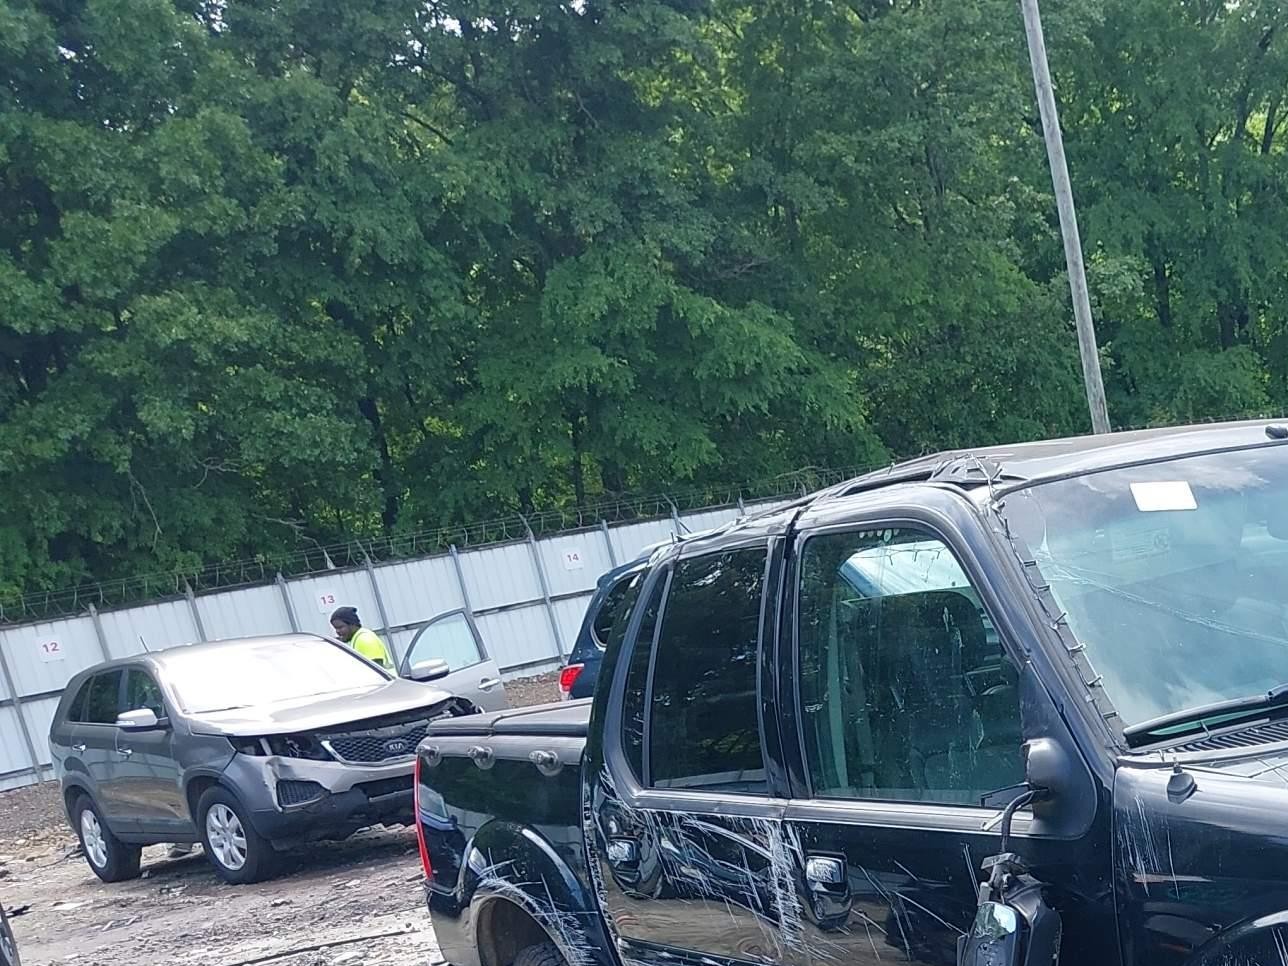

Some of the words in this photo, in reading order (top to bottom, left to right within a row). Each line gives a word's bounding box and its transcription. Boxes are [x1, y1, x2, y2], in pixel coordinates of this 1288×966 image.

[567, 553, 579, 562] 14
[320, 595, 335, 605] 13
[42, 642, 60, 653] 12
